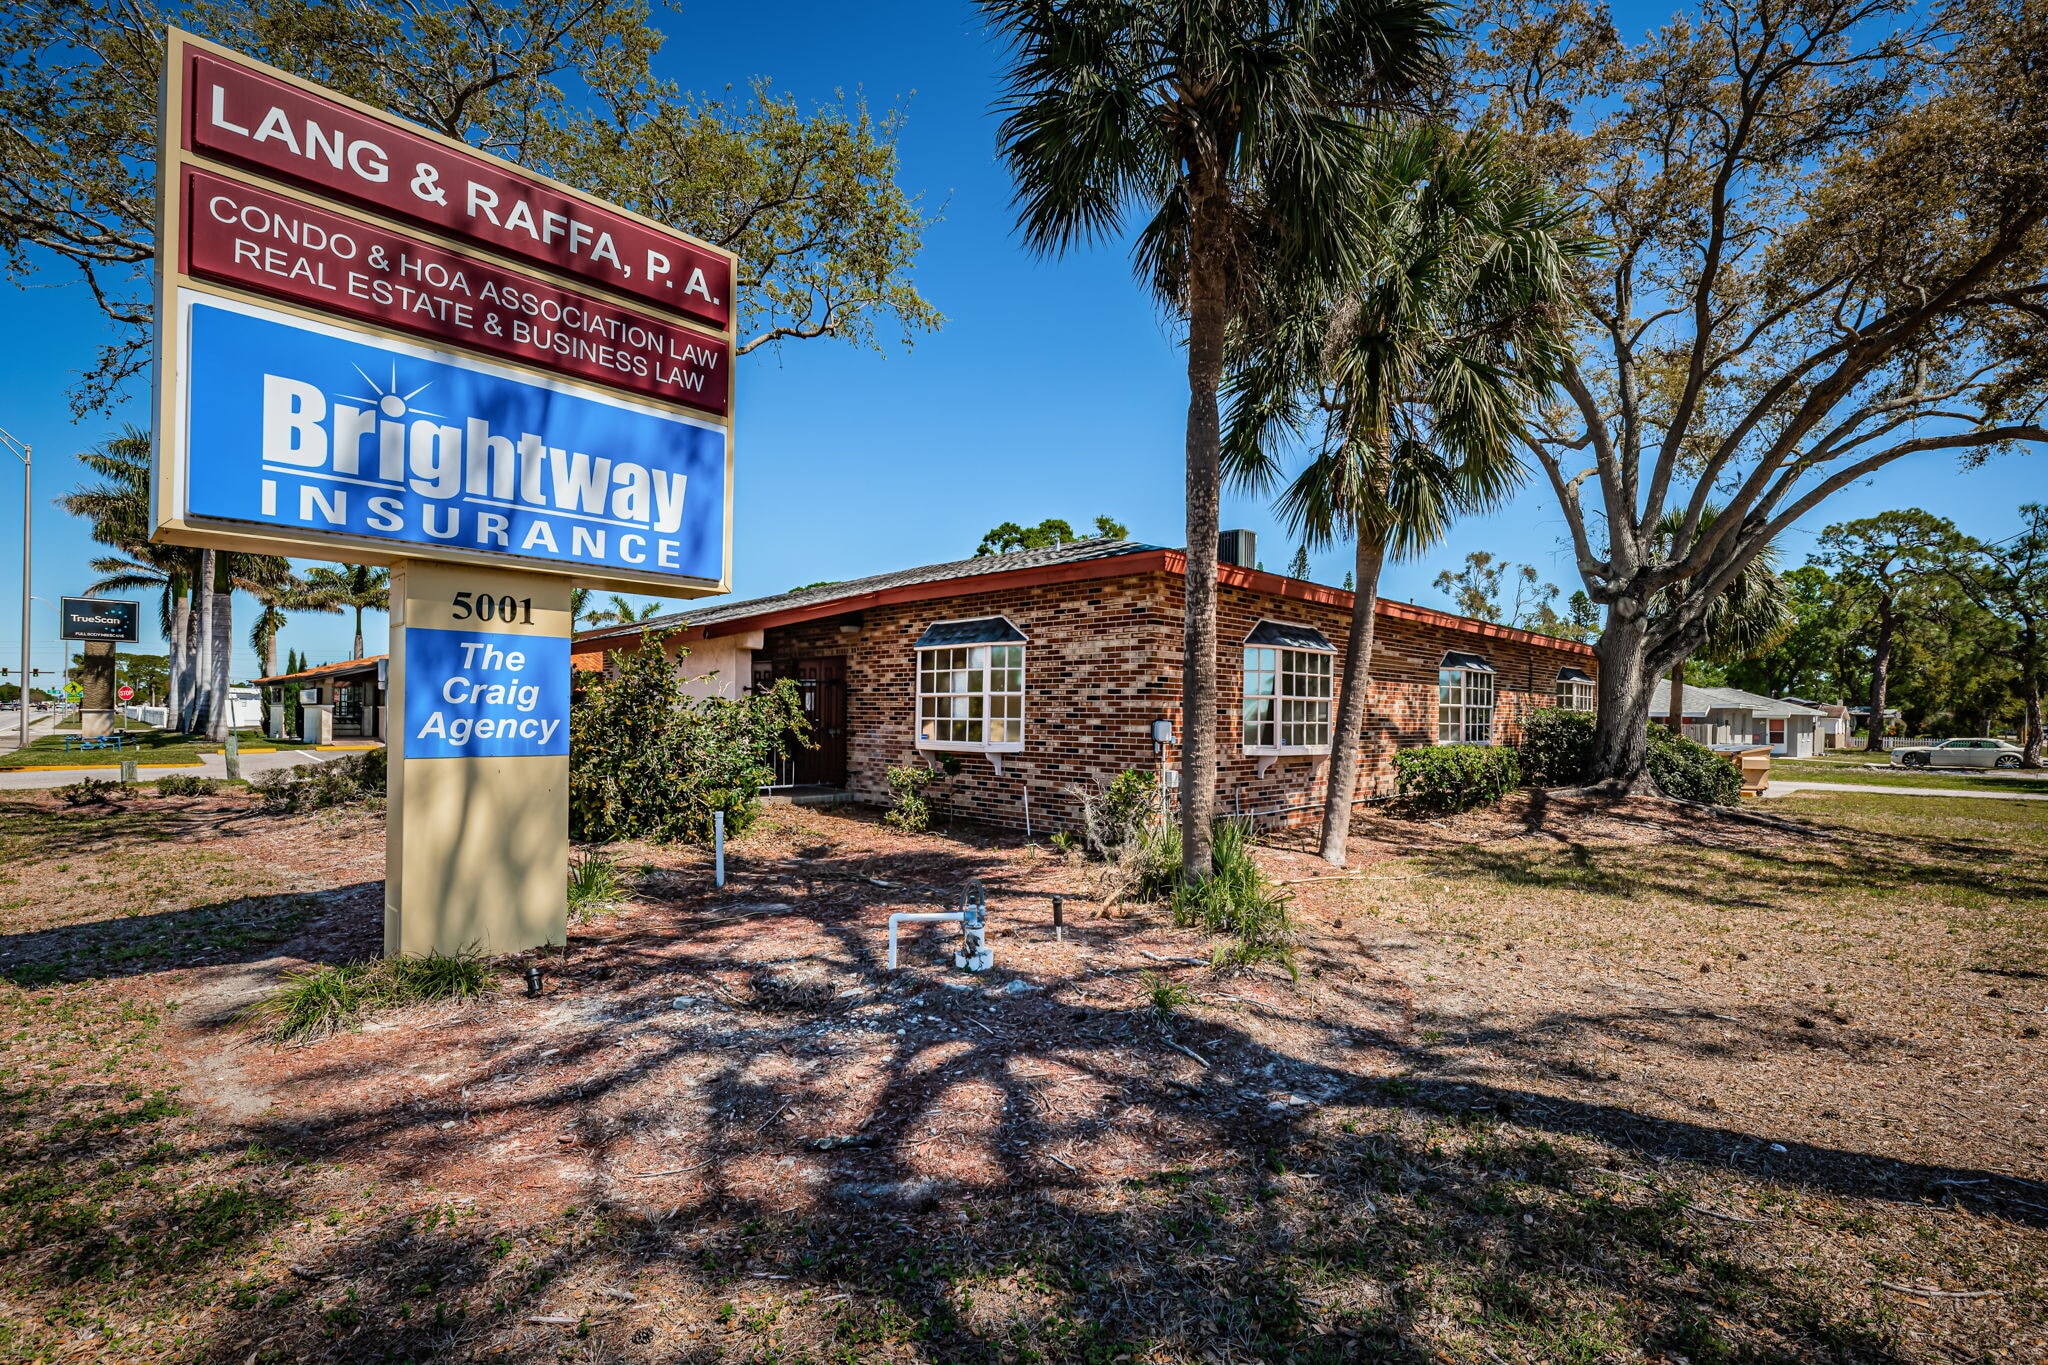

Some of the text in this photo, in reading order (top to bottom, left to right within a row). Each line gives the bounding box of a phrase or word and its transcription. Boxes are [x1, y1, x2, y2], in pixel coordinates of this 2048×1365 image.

[212, 84, 388, 182] LANG
[409, 162, 449, 208] &
[467, 180, 632, 279] RAFFA,
[209, 196, 718, 370] CONDO & HOA ASSOCIATION LAW
[234, 238, 705, 393] REAL ESTATE & BUSINESS LAW
[262, 373, 688, 534] Brightway
[261, 478, 681, 569] INSURANCE
[70, 614, 120, 625] TrueScan
[452, 591, 534, 625] 5001
[460, 642, 526, 672] The
[119, 689, 133, 697] STOP
[442, 676, 540, 713] Craig
[416, 711, 560, 747] Agency
